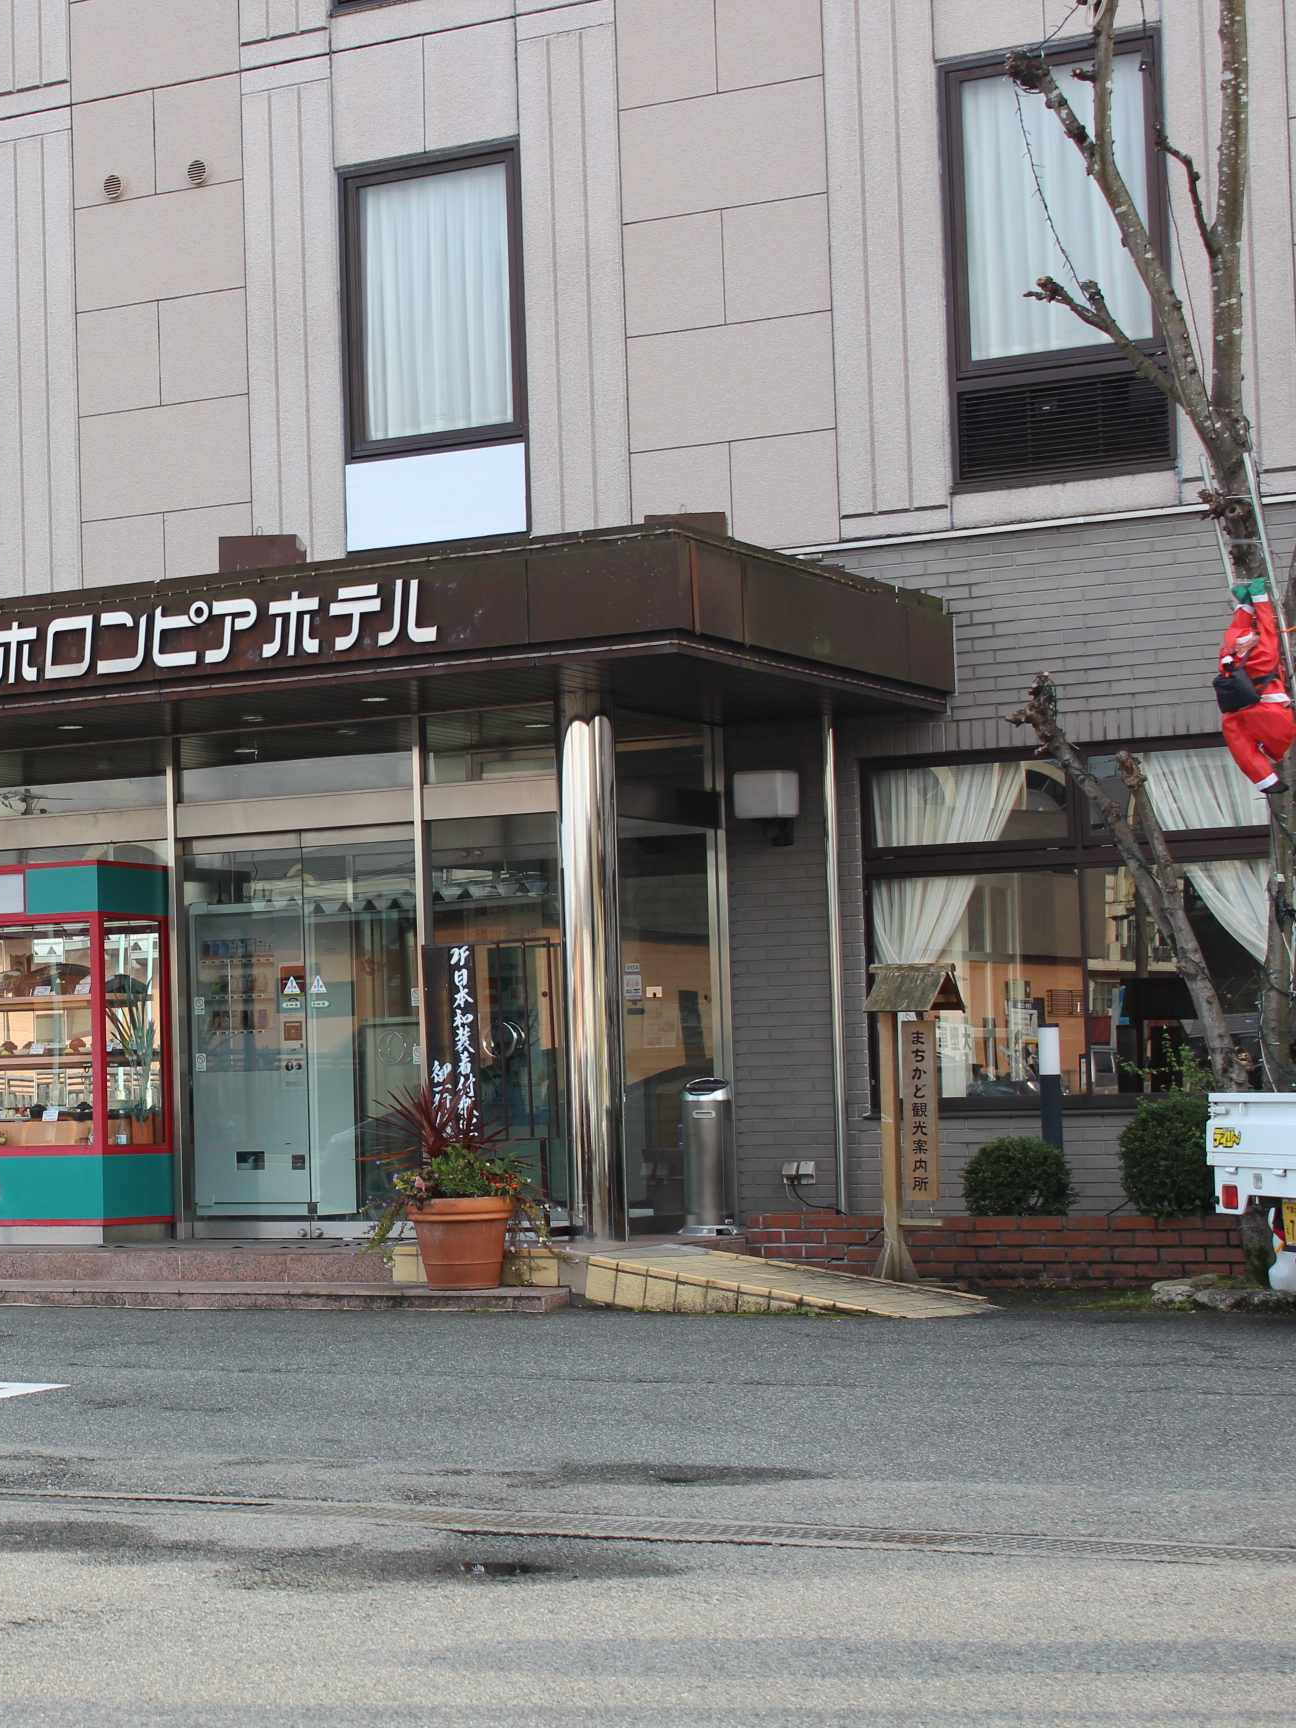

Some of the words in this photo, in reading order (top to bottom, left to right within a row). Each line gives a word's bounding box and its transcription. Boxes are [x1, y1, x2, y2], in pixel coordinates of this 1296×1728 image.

[911, 1030, 929, 1192] まちかど観光案内所
